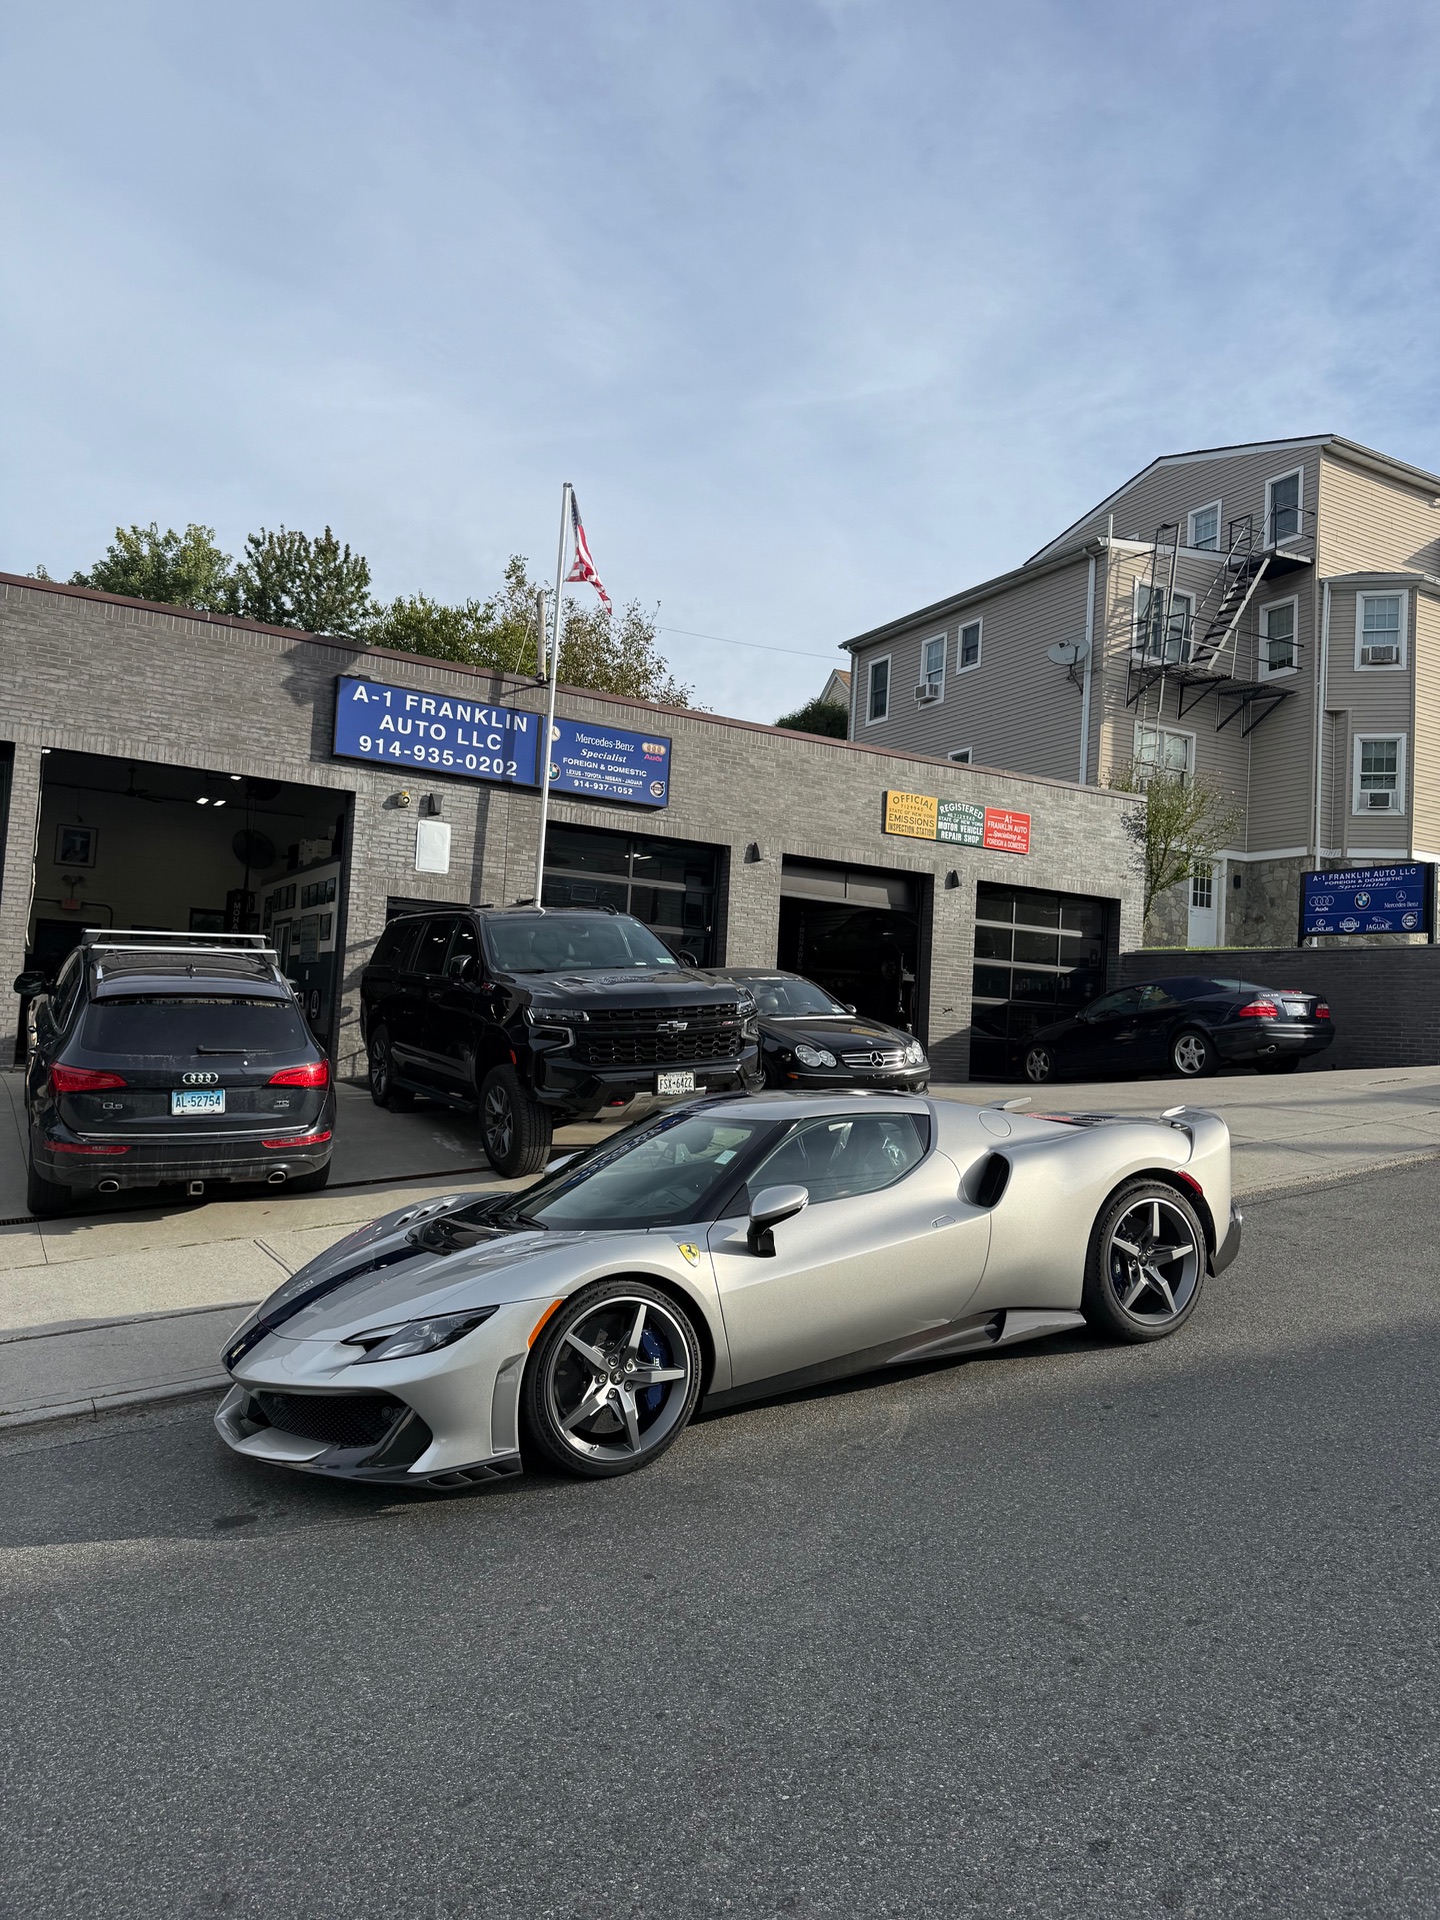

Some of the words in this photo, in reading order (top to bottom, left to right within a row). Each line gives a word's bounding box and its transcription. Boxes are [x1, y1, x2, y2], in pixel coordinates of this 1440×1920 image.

[353, 685, 392, 708] A-1
[406, 694, 527, 732] FRANKLIN
[379, 714, 446, 742] AUTO
[457, 726, 502, 751] LLC
[575, 732, 635, 752] Mercedes-Benz
[358, 734, 518, 777] 914-935-0202
[580, 748, 628, 763] Specialist
[562, 757, 599, 770] FOREIGN
[600, 763, 606, 771] &
[607, 765, 647, 777] DOMESTIC
[566, 768, 582, 776] LEXUS
[584, 771, 601, 779] TOYOTA
[605, 774, 622, 783] NISSAN
[624, 778, 643, 786] JAGUAR
[573, 779, 634, 796] 914-937-1052
[892, 794, 933, 811] OFFICIAL
[888, 807, 903, 815] STATE
[939, 802, 984, 820] REGISTERED
[888, 813, 935, 828] EMISSIONS
[1004, 814, 1013, 824] A1
[887, 822, 915, 835] INSPECTION
[916, 826, 935, 838] STATION
[937, 821, 958, 832] MOTOR
[960, 824, 984, 836] VEHICLE
[987, 820, 1013, 832] FRANKLIN
[1013, 825, 1028, 835] AUTO
[940, 830, 962, 842] REPAIR
[963, 834, 980, 844] SHOP
[986, 837, 1004, 847] FOREIGN
[1007, 841, 1027, 850] DOMESTIC
[1312, 874, 1326, 882] A-1
[1328, 871, 1371, 880] FRANKLIN
[1373, 868, 1397, 877] AUTO
[1400, 867, 1417, 876] LLC
[1364, 876, 1403, 884] DOMESTIC
[1337, 881, 1389, 890] Specialist
[1366, 923, 1390, 931] JAGUAR
